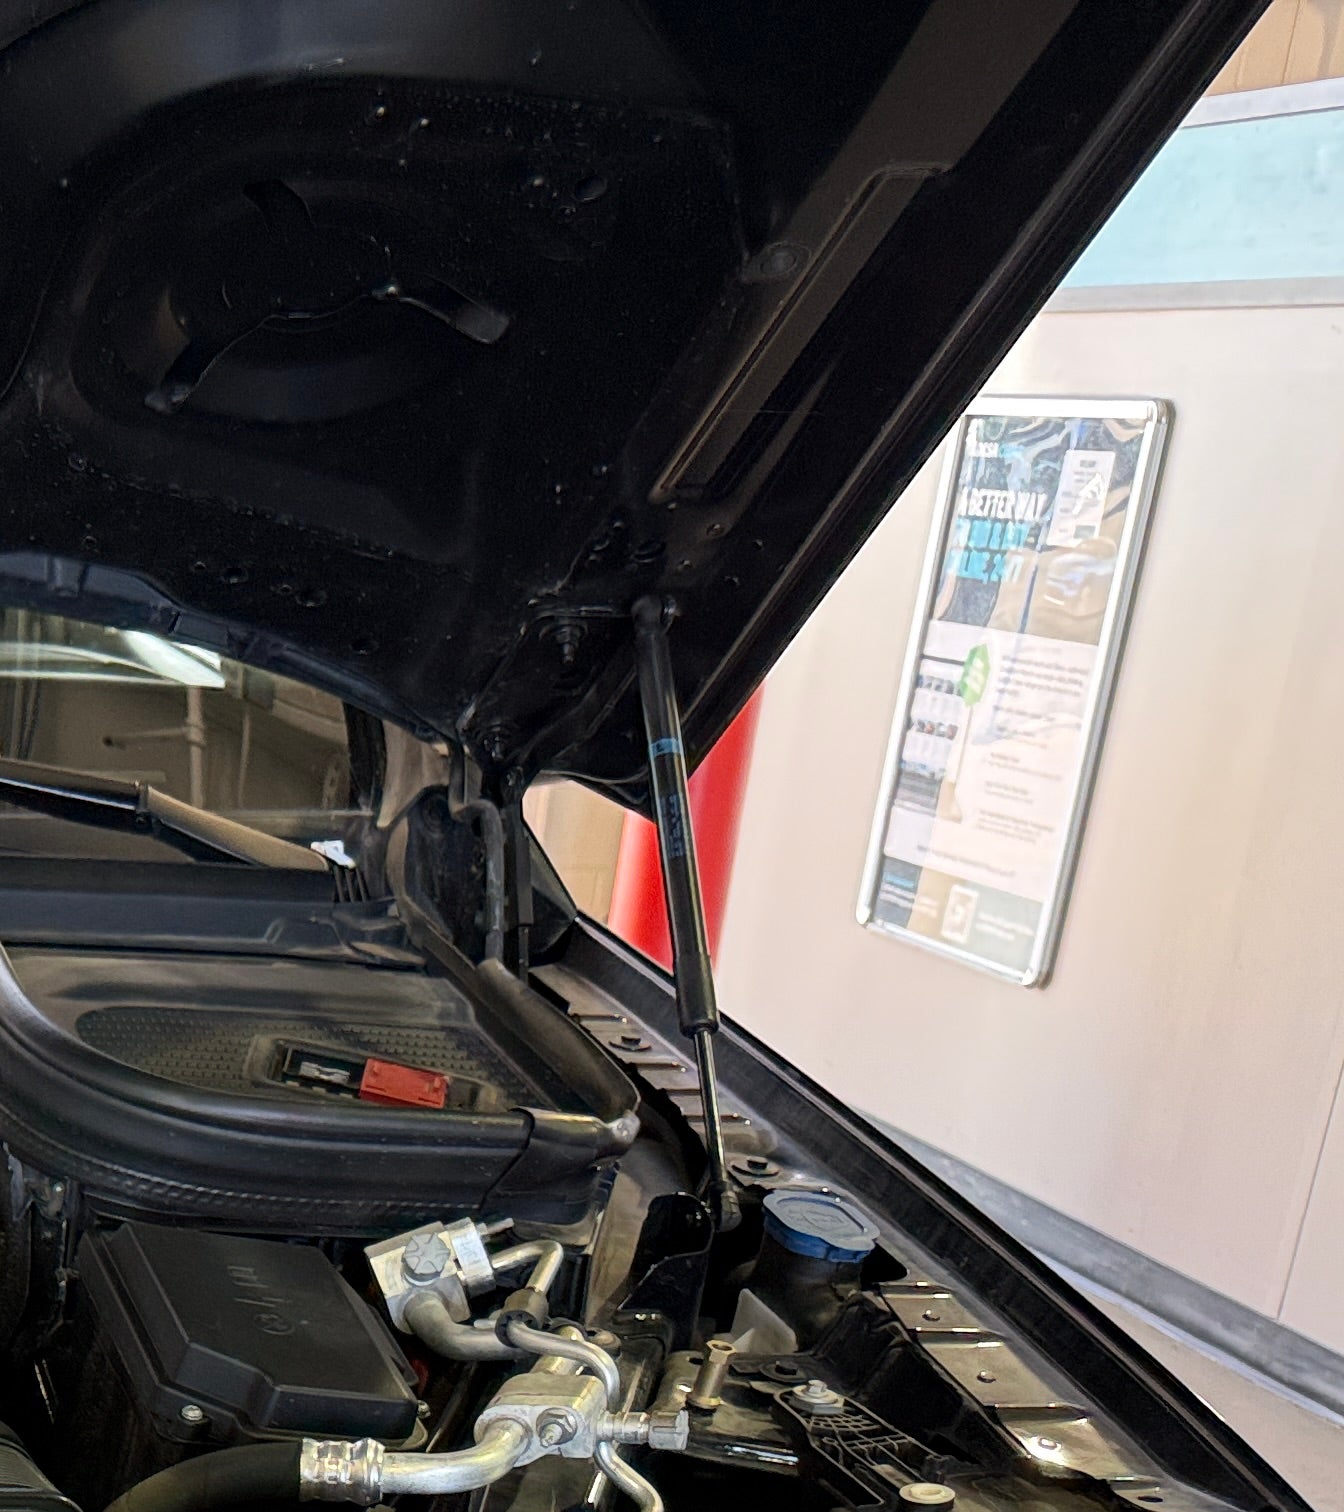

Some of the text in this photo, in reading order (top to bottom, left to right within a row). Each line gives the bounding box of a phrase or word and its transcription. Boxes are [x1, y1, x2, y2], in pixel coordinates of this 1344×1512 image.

[958, 487, 1047, 521] A BETTER WAY
